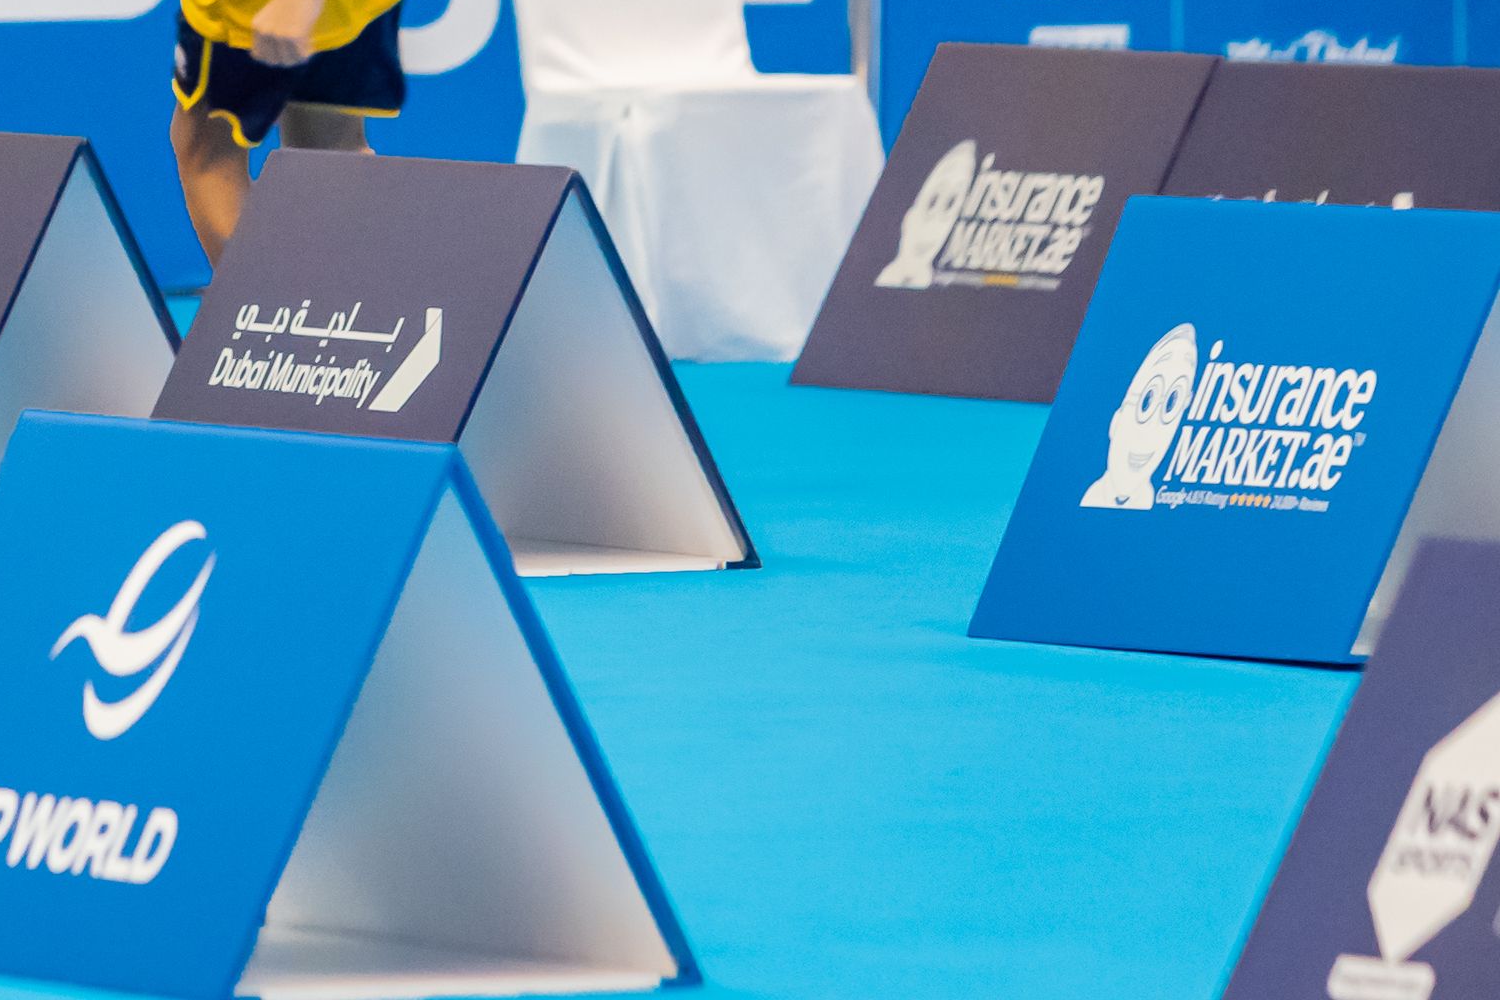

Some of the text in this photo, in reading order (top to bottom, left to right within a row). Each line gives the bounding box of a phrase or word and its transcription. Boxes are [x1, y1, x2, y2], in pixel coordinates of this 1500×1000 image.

[963, 152, 1106, 227] insurance
[231, 298, 406, 353] بلدية دبي
[208, 347, 382, 409] Dubai Municipality
[1187, 339, 1378, 431] insurance
[1163, 425, 1353, 491] MARKET.ae
[1155, 485, 1188, 510] Google
[4, 791, 181, 886] WORLD
